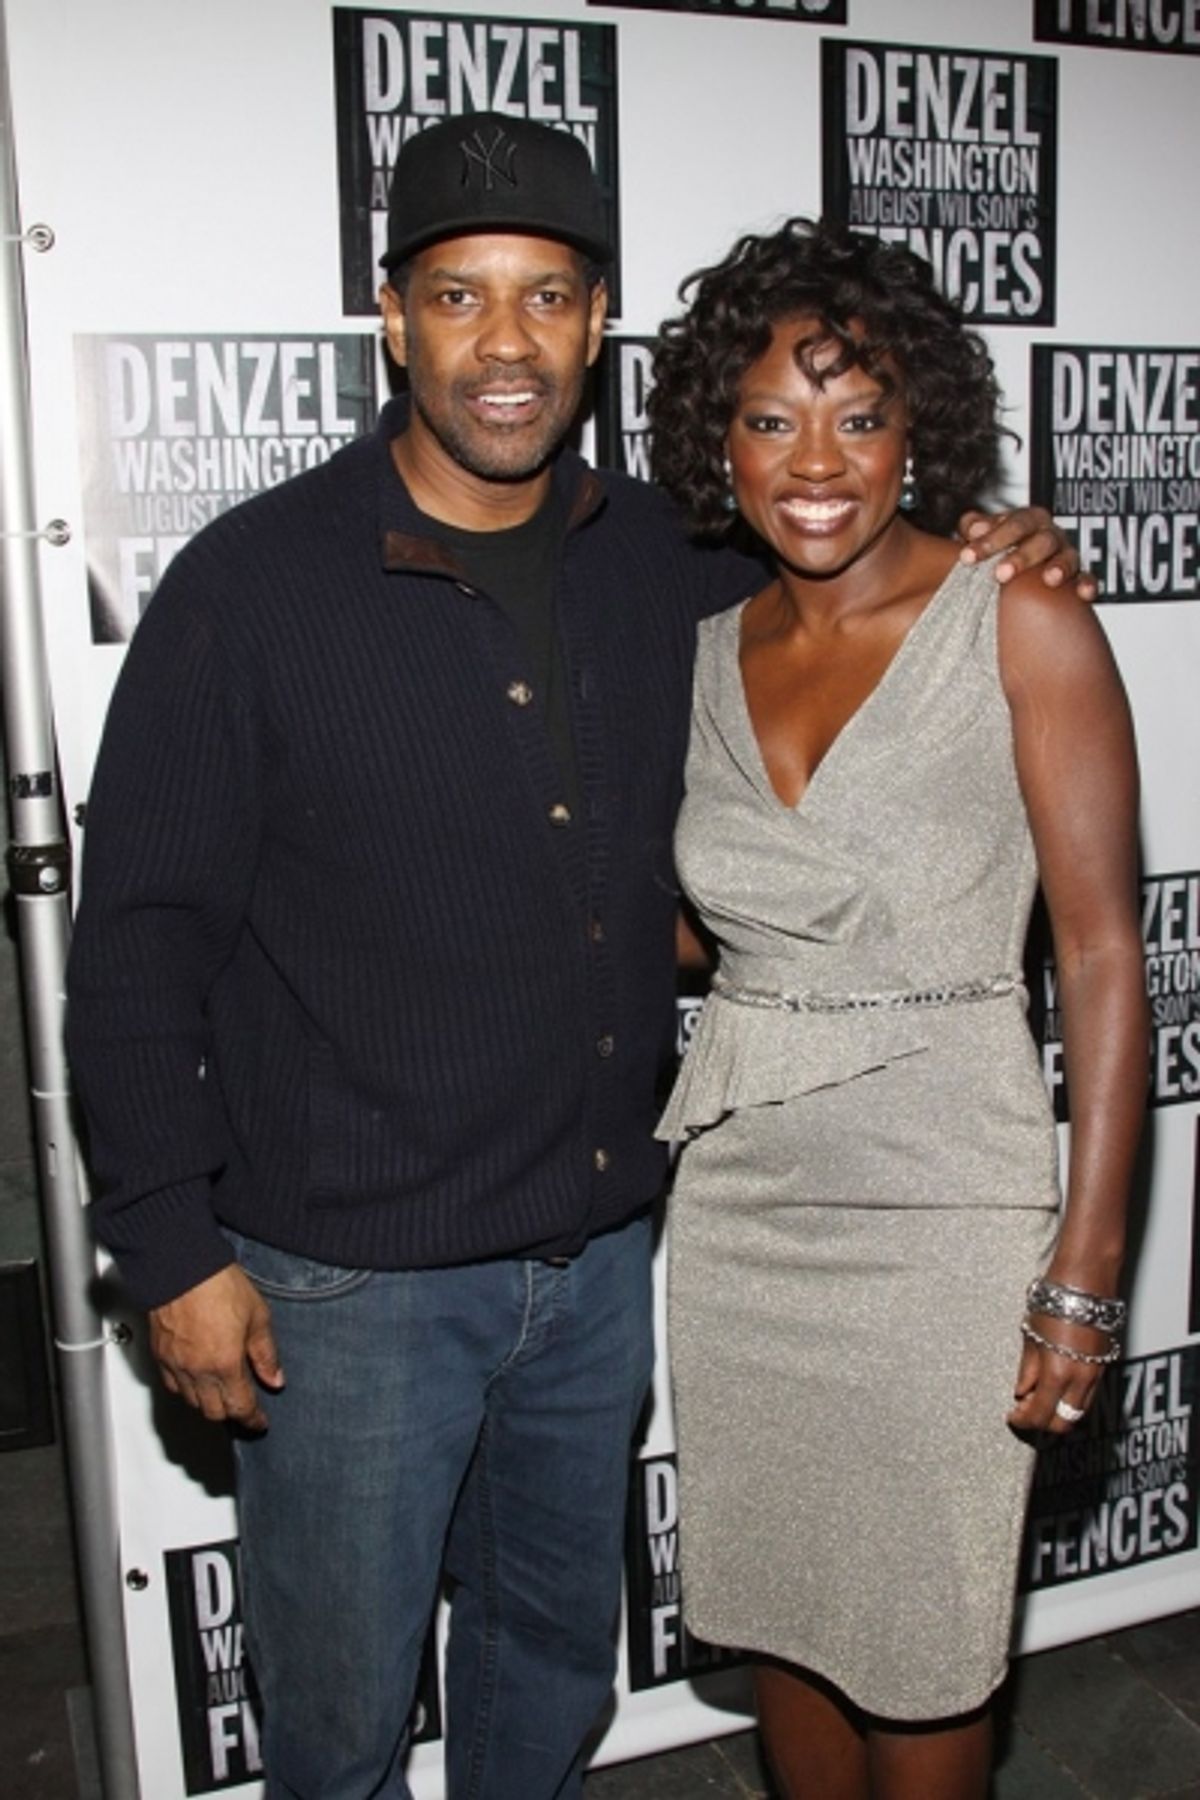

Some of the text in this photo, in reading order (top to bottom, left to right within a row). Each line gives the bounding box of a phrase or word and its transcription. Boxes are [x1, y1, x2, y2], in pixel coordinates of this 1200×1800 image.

[362, 17, 598, 122] DENZEL
[845, 47, 1041, 146] DENZEL
[847, 137, 1038, 195] WASHINGTON
[849, 188, 1038, 231] AUGUST WILSON'S
[104, 341, 356, 437] DENZEL
[1054, 480, 1130, 515] AUGUST
[1053, 513, 1200, 595] ENCE
[1143, 878, 1200, 954] ZEL
